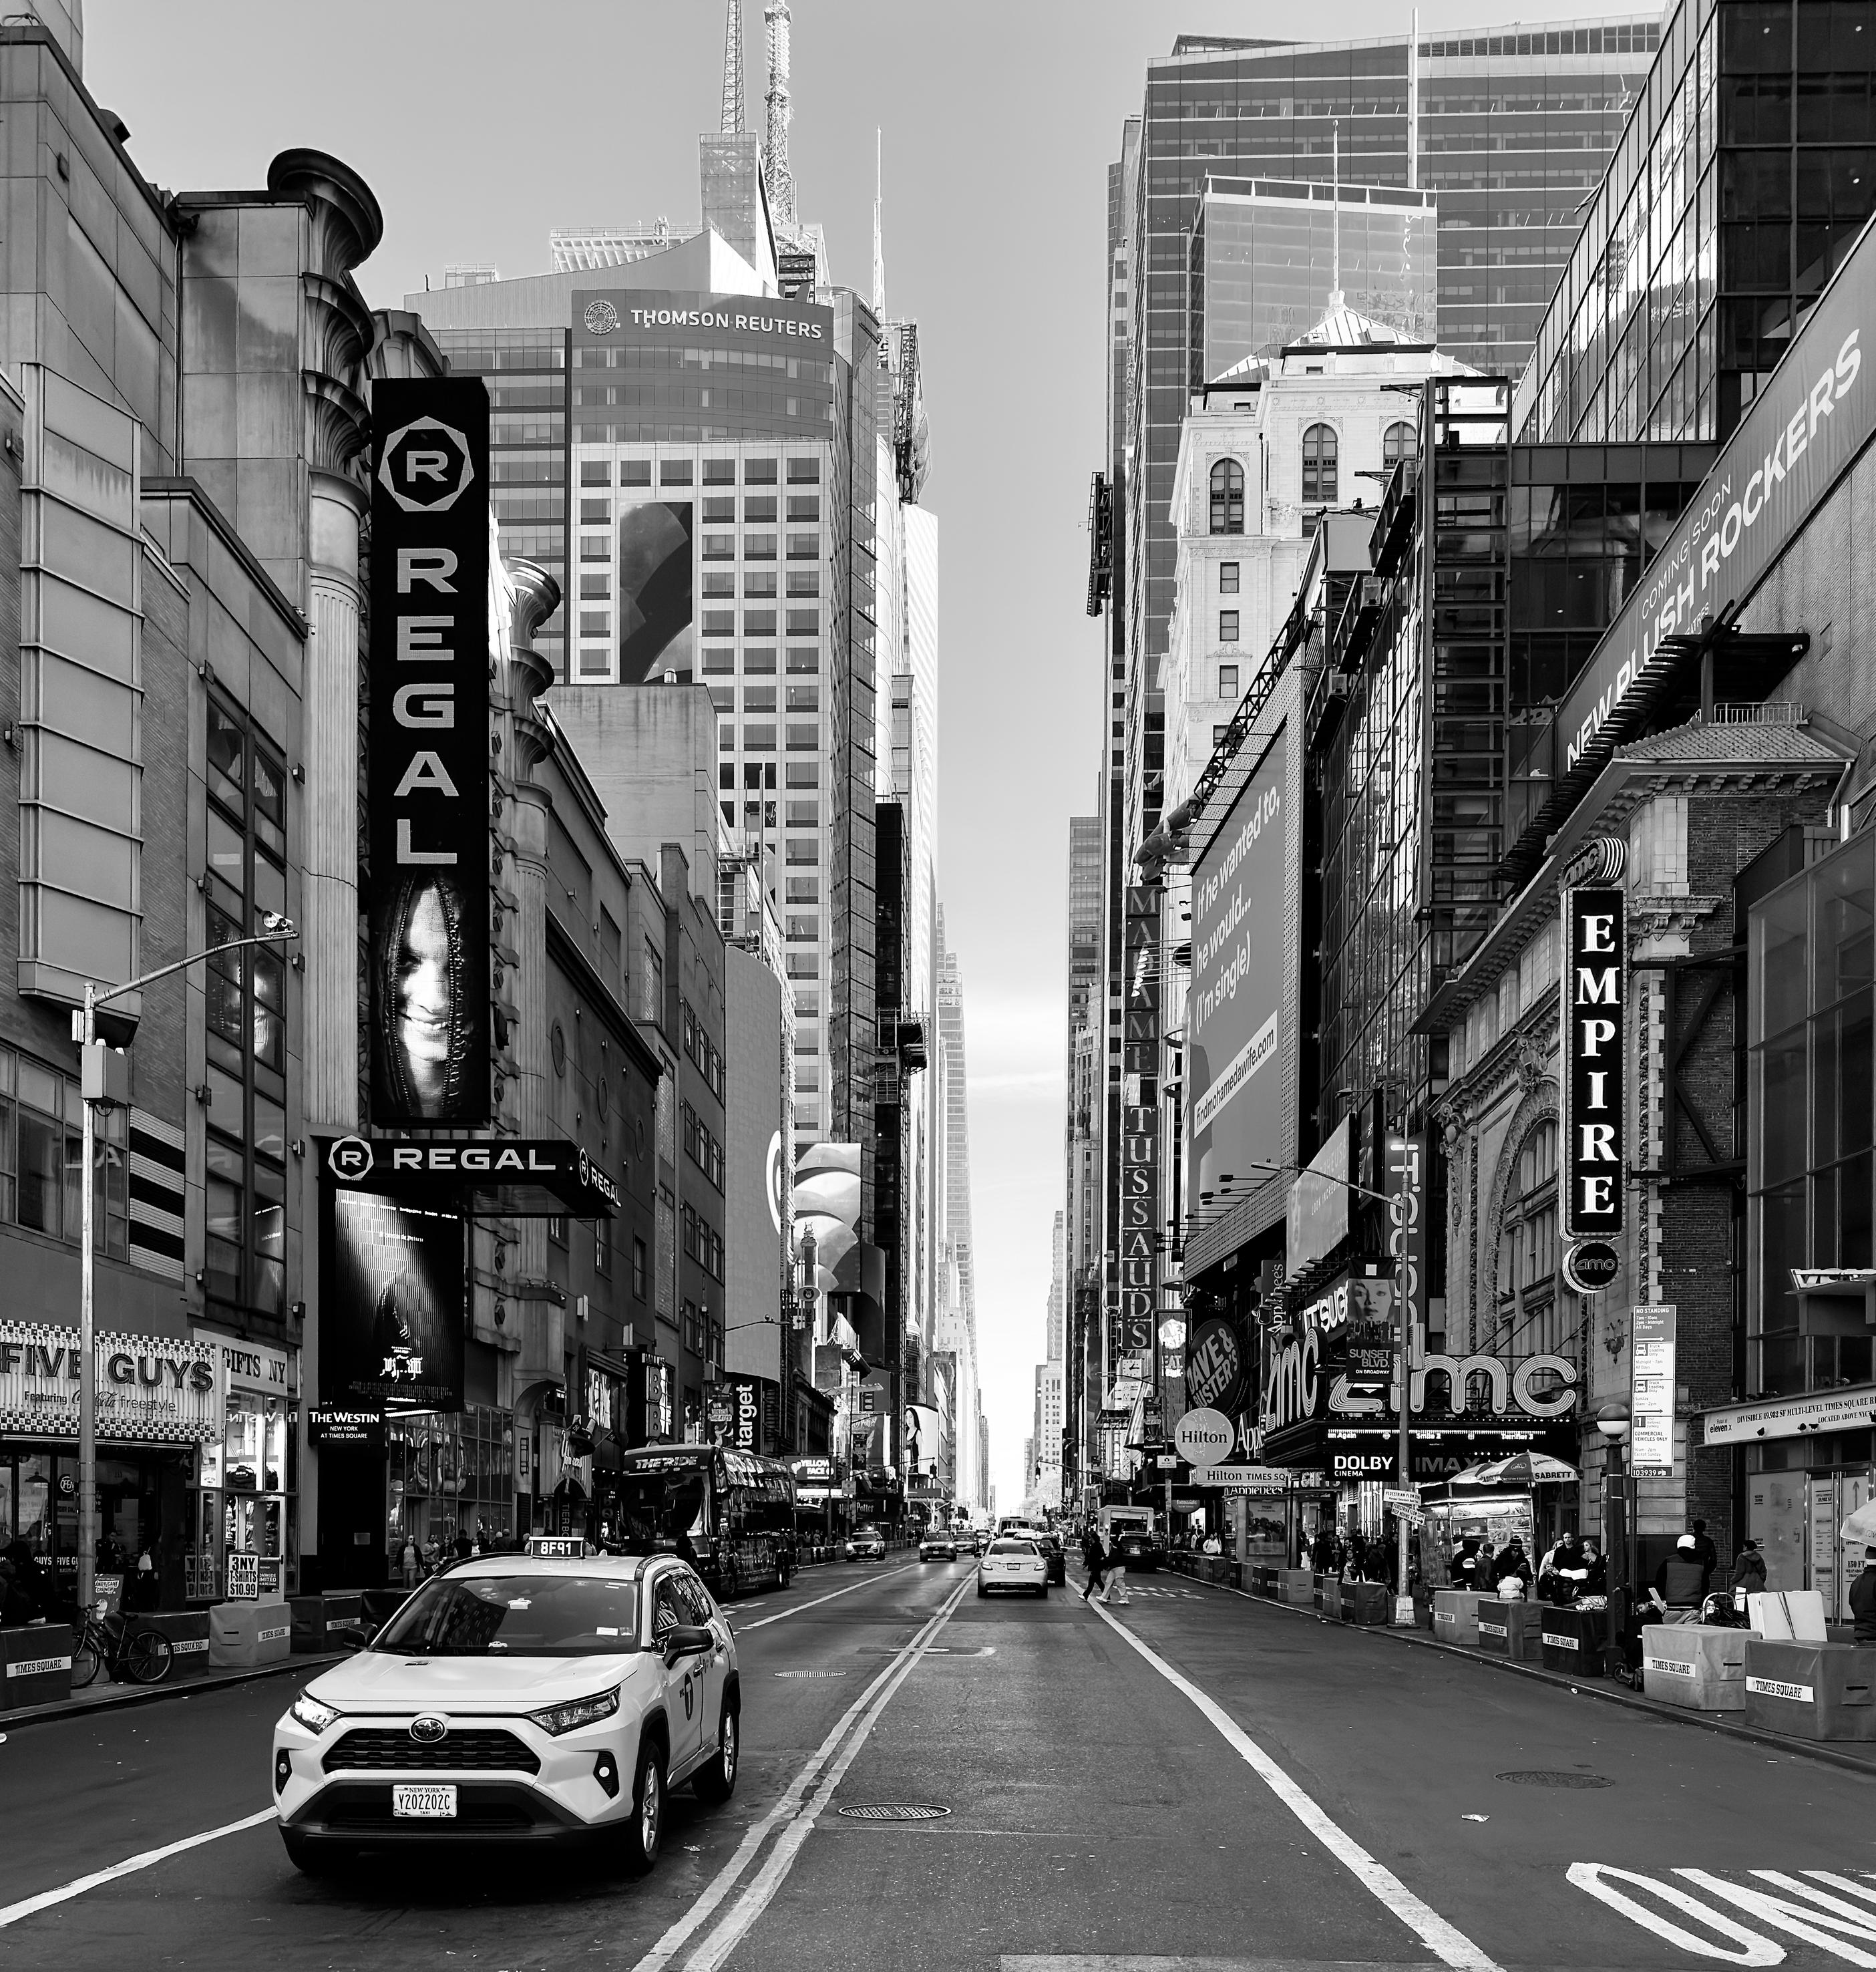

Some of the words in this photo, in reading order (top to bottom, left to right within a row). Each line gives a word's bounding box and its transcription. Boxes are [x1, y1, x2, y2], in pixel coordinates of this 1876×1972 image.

[631, 309, 729, 328] THOMSON
[735, 315, 822, 339] REUTERS
[1565, 685, 1613, 772] NEW
[1616, 572, 1695, 707] PLUSH
[1701, 329, 1862, 591] ROCKERS
[1642, 545, 1689, 620] COMING
[1692, 475, 1732, 546] SOON
[393, 548, 459, 864] REGAL
[1197, 883, 1205, 925] If
[1205, 876, 1217, 913] he
[1220, 795, 1262, 890] wanted
[1264, 786, 1280, 825] to,
[1563, 848, 1598, 889] amc
[1197, 944, 1208, 979] he
[1209, 883, 1252, 959] would...
[1196, 989, 1213, 1035] (I'm
[1215, 929, 1251, 1007] single)
[1575, 914, 1620, 1214] EMPIRE
[1195, 1028, 1275, 1128] findmohamedawife.com
[393, 1148, 556, 1170] REGAL
[591, 1165, 622, 1208] REGAL
[1575, 1258, 1616, 1271] amc
[1187, 1333, 1225, 1395] DAVE
[1218, 1327, 1235, 1353] &
[1349, 1348, 1391, 1359] SUNSET
[0, 1342, 80, 1379] FIVE
[108, 1353, 214, 1391] GUYS
[222, 1347, 260, 1378] GIFTS
[268, 1359, 286, 1384] NY
[1362, 1358, 1390, 1368] BLVD.
[24, 1390, 67, 1406] Featuring
[120, 1395, 177, 1413] freestyle
[309, 1412, 333, 1423] THE
[333, 1412, 379, 1423] WESTIN
[736, 1384, 757, 1447] target
[1737, 1412, 1762, 1424] DIVISIBLE
[1779, 1410, 1787, 1418] SF
[1787, 1404, 1824, 1417] MULTI-LEVEL
[1825, 1402, 1843, 1411] TIMES
[1843, 1398, 1869, 1410] SQUARE
[1818, 1414, 1841, 1424] LOCATED
[1841, 1412, 1858, 1421] ABOVE
[1181, 1430, 1228, 1443] Hilton
[1710, 1424, 1727, 1434] eleven
[635, 1459, 661, 1469] THE
[663, 1456, 699, 1467] RIDE
[1334, 1456, 1393, 1470] DOLBY
[1415, 1457, 1480, 1473] IMAX
[1207, 1470, 1242, 1480] Hilton
[1535, 1472, 1571, 1480] SABRETT
[540, 1542, 571, 1555] 8F91
[34, 1556, 52, 1566] GUYS
[57, 1556, 70, 1566] FIVE
[232, 1556, 255, 1571] 3NY
[230, 1571, 256, 1583] T-SHIRTS
[230, 1583, 256, 1596] $10.99
[180, 1642, 203, 1652] SQUARE
[15, 1663, 35, 1674] TIMES
[37, 1659, 61, 1671] SQUARE
[1652, 1659, 1668, 1671] TIMES
[1668, 1661, 1690, 1675] SQUARE
[1755, 1680, 1775, 1694] TIMES
[1776, 1683, 1803, 1699] SQUARE
[399, 1794, 450, 1810] Y202202C
